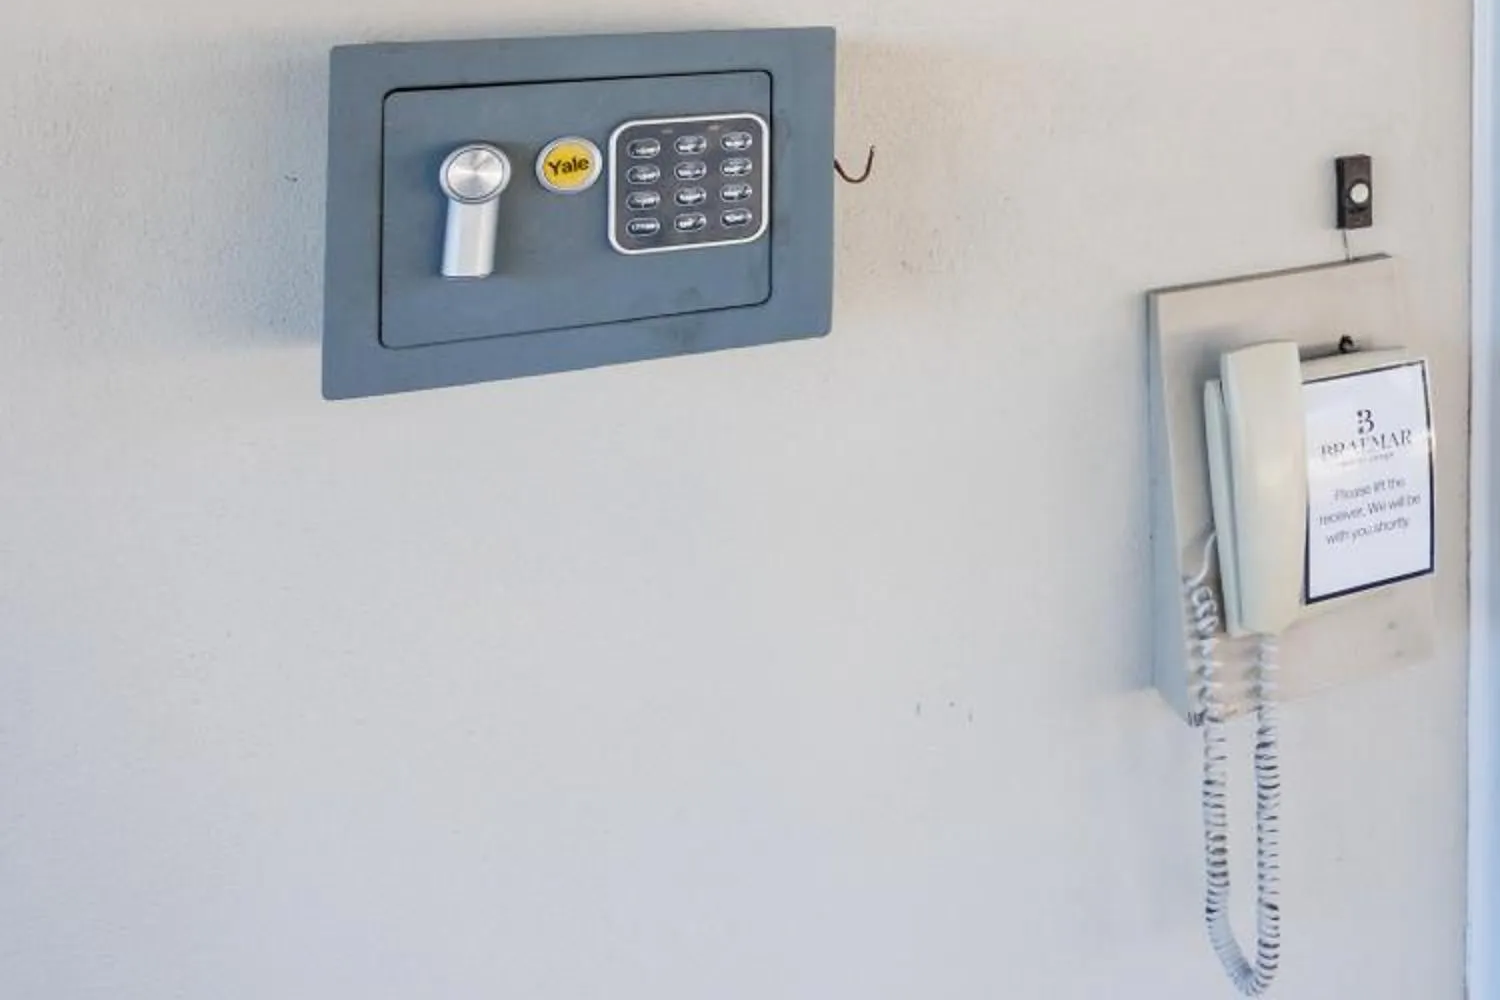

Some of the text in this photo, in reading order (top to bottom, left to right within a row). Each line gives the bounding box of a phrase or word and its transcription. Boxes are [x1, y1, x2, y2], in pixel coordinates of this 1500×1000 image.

[547, 155, 590, 177] Yale
[1334, 483, 1371, 501] Please
[1387, 477, 1406, 490] the
[1367, 501, 1387, 515] We
[1388, 494, 1405, 510] will
[1406, 493, 1421, 507] be
[1326, 529, 1350, 545] with
[1351, 527, 1371, 545] you
